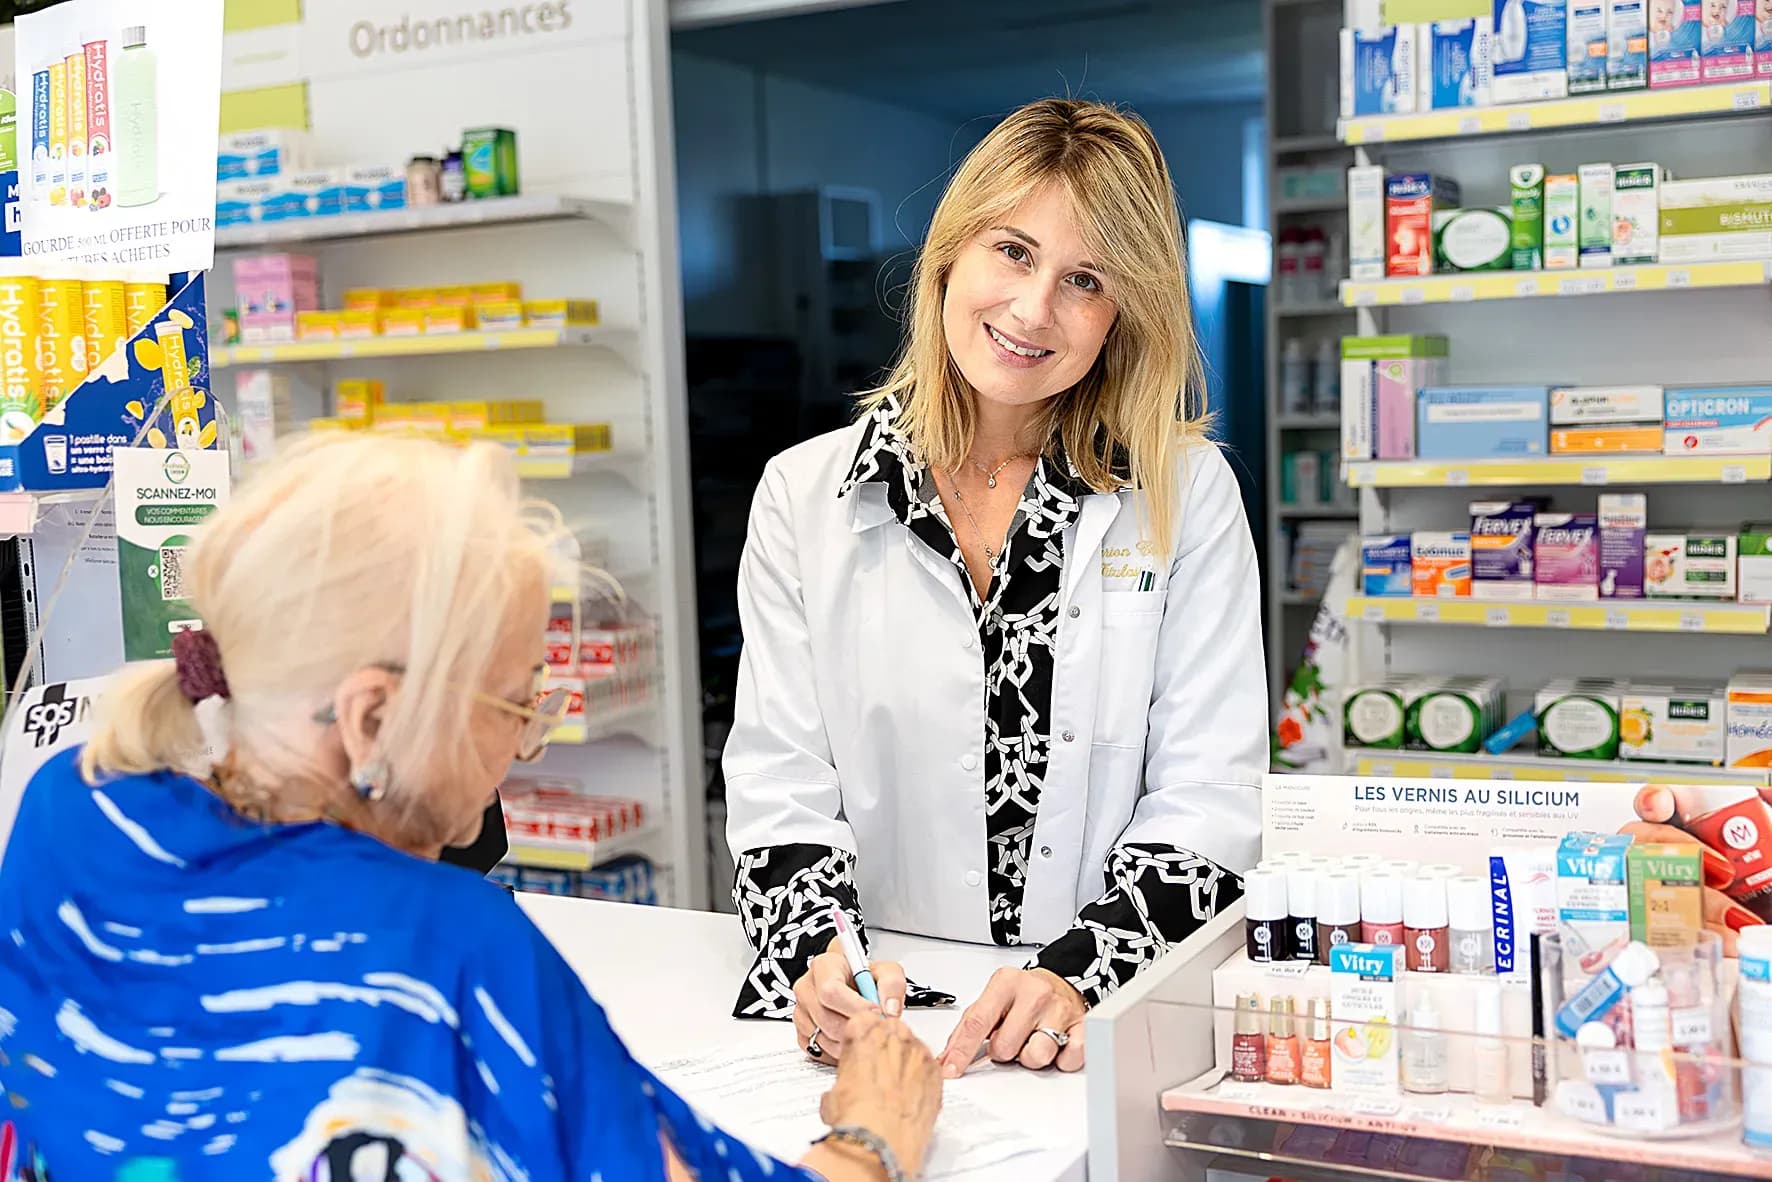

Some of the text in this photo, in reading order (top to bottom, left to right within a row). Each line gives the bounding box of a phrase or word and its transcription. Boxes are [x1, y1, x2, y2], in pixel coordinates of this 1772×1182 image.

[349, 1, 573, 58] Ordonnances
[90, 44, 107, 127] Hydratis
[39, 72, 49, 138] Hydratis
[23, 235, 75, 256] GOURDE
[109, 221, 168, 244] OFFERTE
[171, 216, 211, 235] POUR
[111, 242, 171, 265] ACHETES
[1, 283, 31, 399] Hydratis
[40, 287, 64, 398] Hydratis
[1667, 397, 1752, 417] OPTICRON
[75, 433, 106, 447] pastille
[107, 434, 128, 444] dans
[83, 447, 105, 455] verre
[136, 487, 217, 500] SCANNEZ-MOI
[27, 700, 75, 732] SOS
[1354, 785, 1580, 807] LES VERNIS AU SILICIUM
[1355, 804, 1371, 813] Pour
[1426, 807, 1447, 815] même
[1460, 809, 1474, 818] plus
[1565, 857, 1615, 881] Vitry
[1646, 859, 1695, 881] Vitry
[1494, 874, 1512, 970] ECRINAL
[1339, 953, 1385, 976] Vitry
[1248, 1104, 1287, 1118] CLEAN
[1301, 1110, 1352, 1125] SILICIUM
